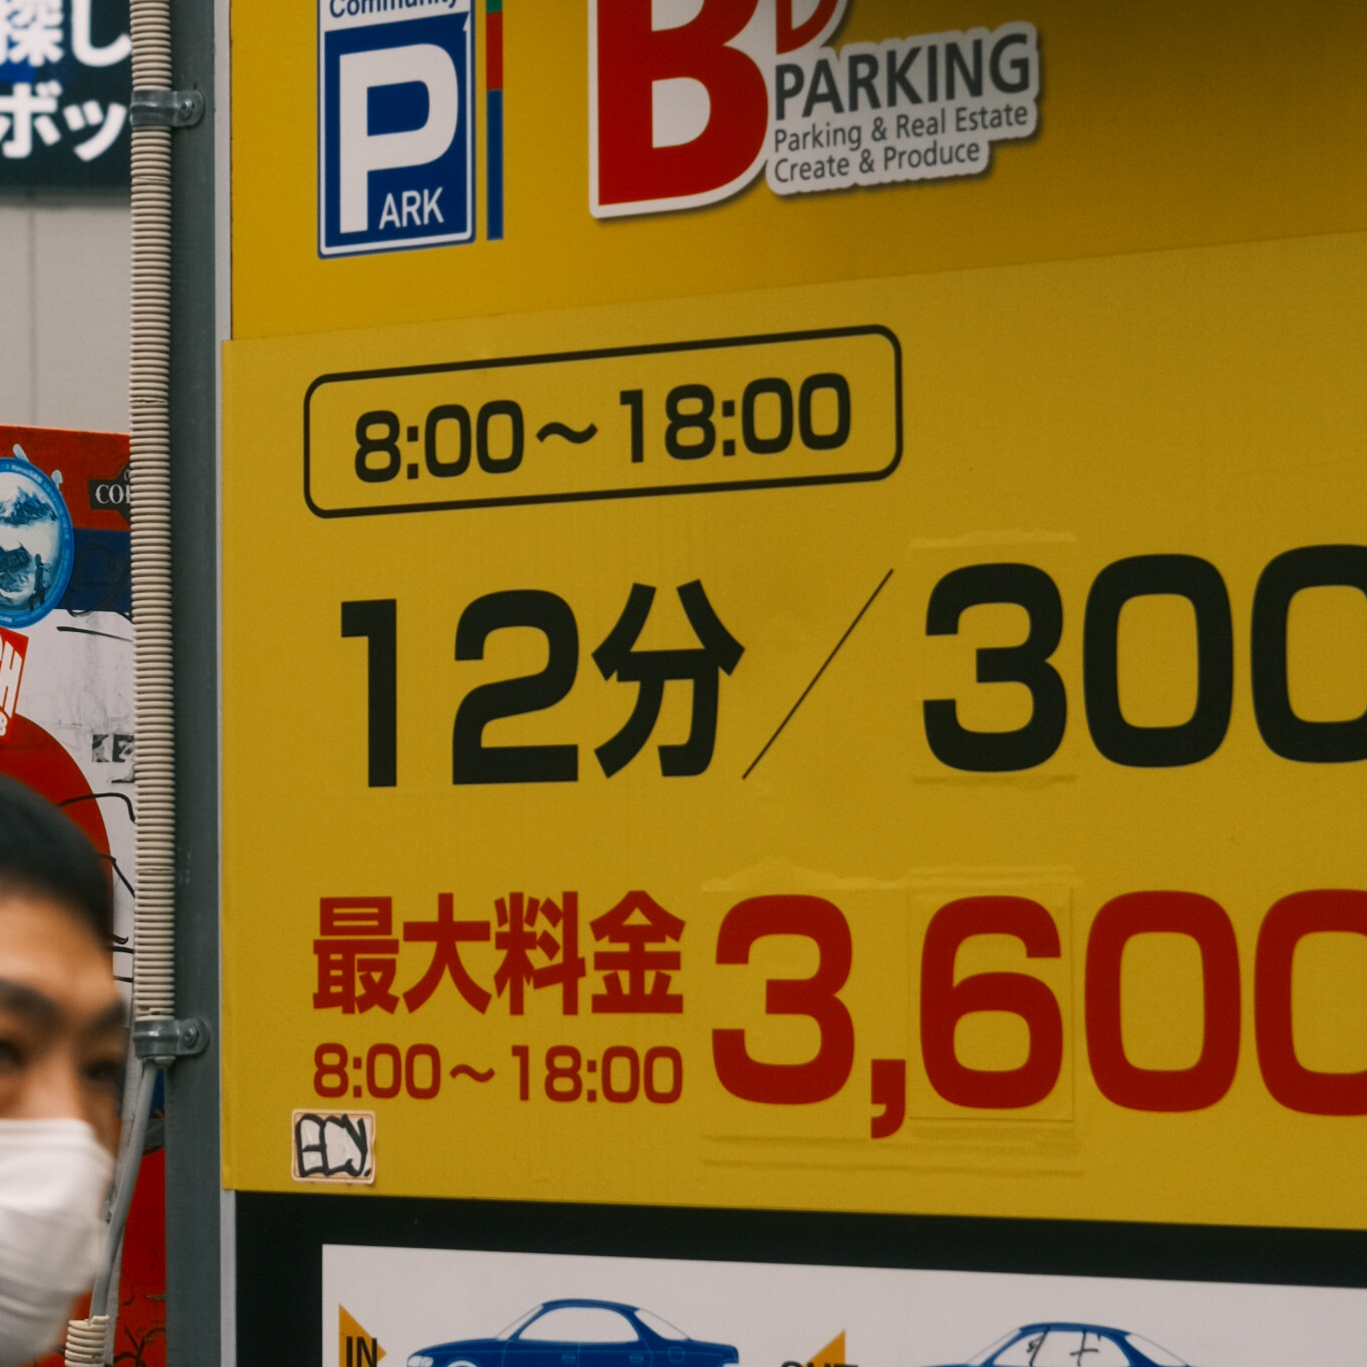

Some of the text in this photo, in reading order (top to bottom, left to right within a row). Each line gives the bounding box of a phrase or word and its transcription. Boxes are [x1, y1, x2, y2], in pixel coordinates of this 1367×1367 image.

[774, 33, 1032, 121] PARKING
[774, 102, 1029, 154] Parking & Real Estate
[774, 139, 981, 184] Create & Produce
[312, 889, 687, 1017] 最大料金
